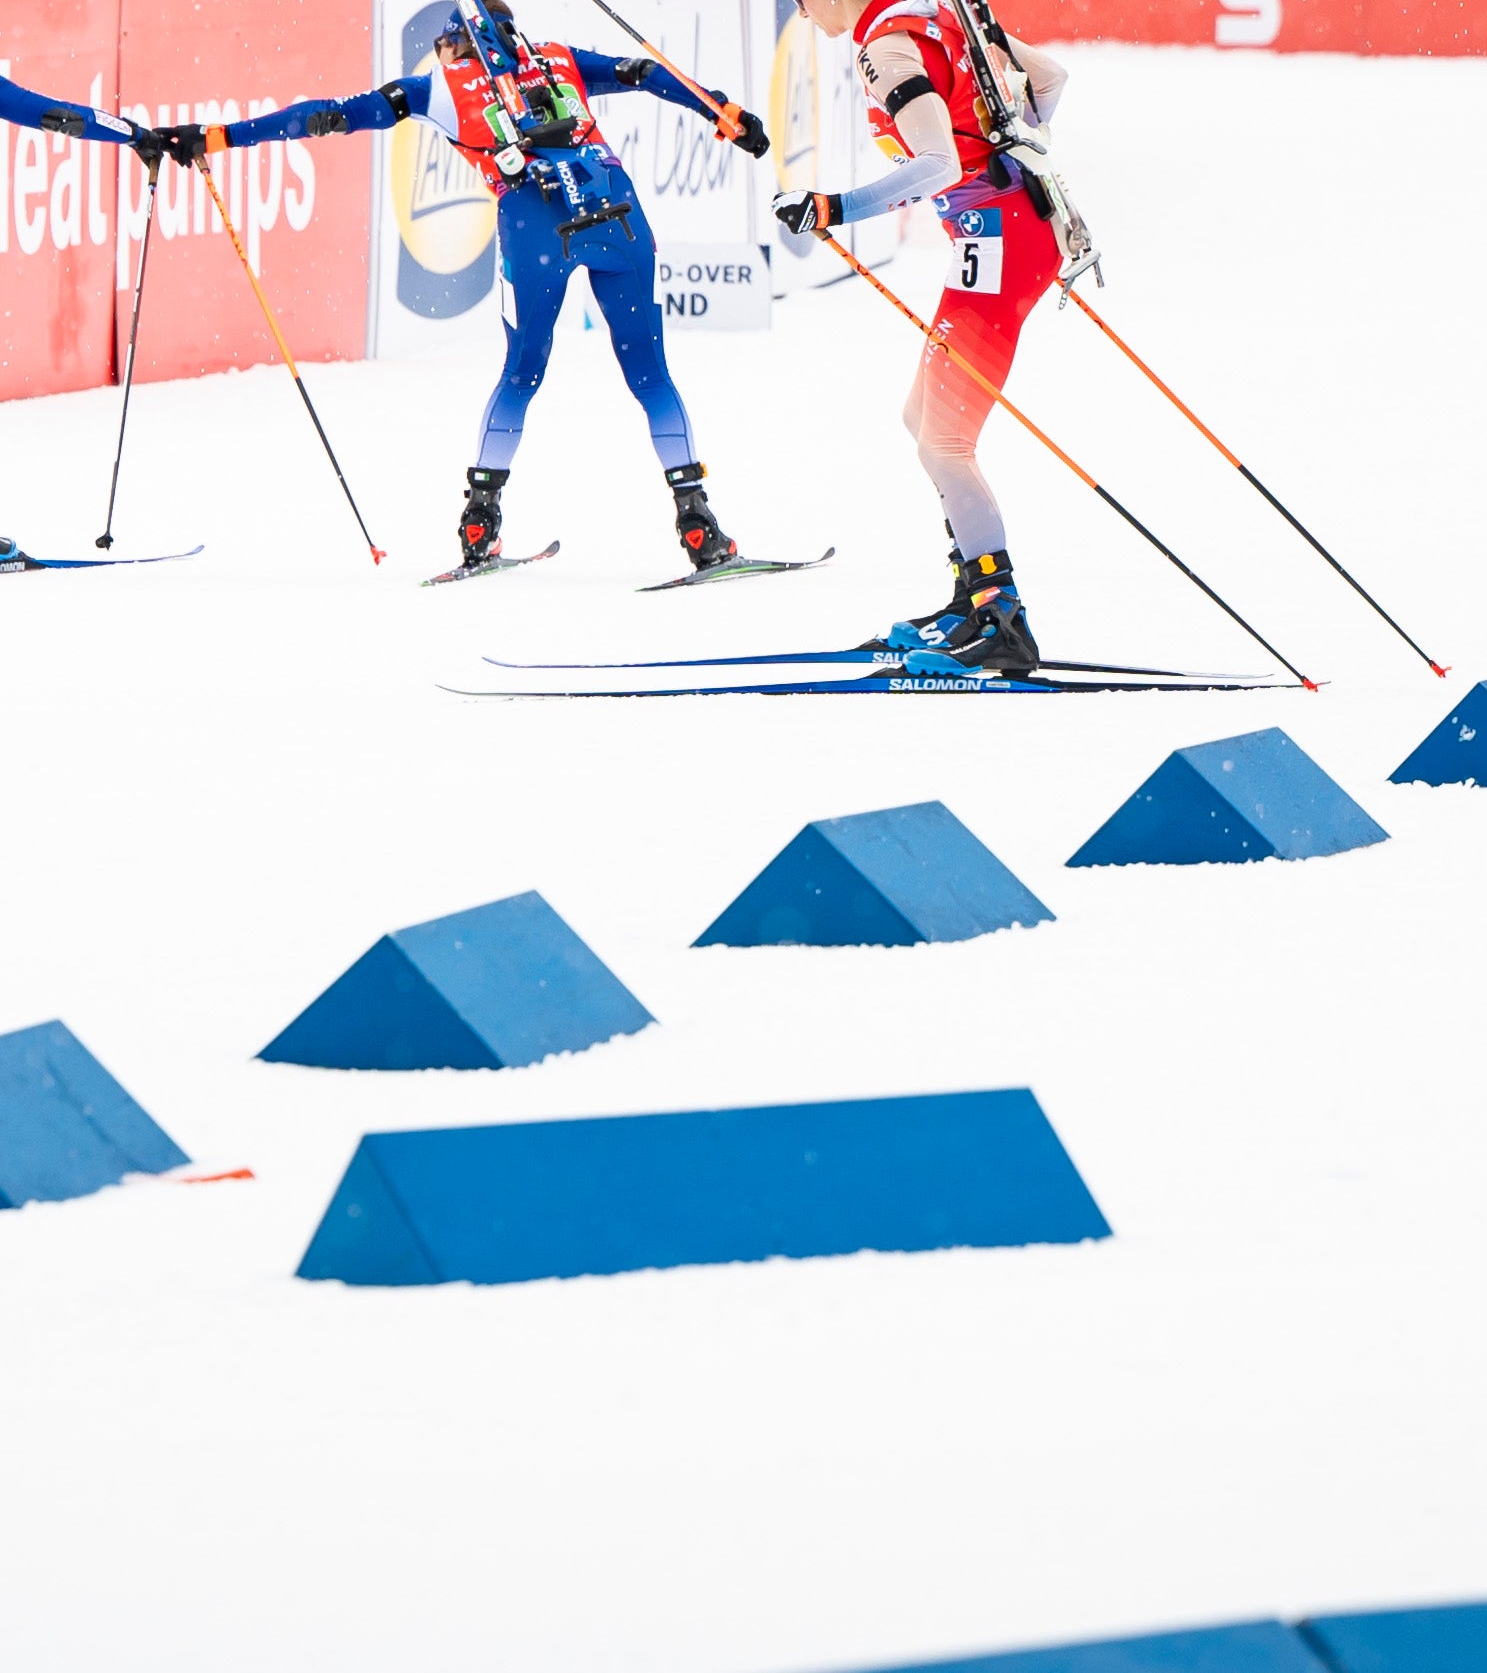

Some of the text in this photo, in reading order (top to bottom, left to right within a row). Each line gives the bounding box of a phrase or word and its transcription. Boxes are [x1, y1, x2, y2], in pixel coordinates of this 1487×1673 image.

[557, 161, 583, 205] FIOCCHI
[961, 243, 979, 288] 5
[666, 292, 709, 317] ND
[889, 679, 983, 691] SALOMON
